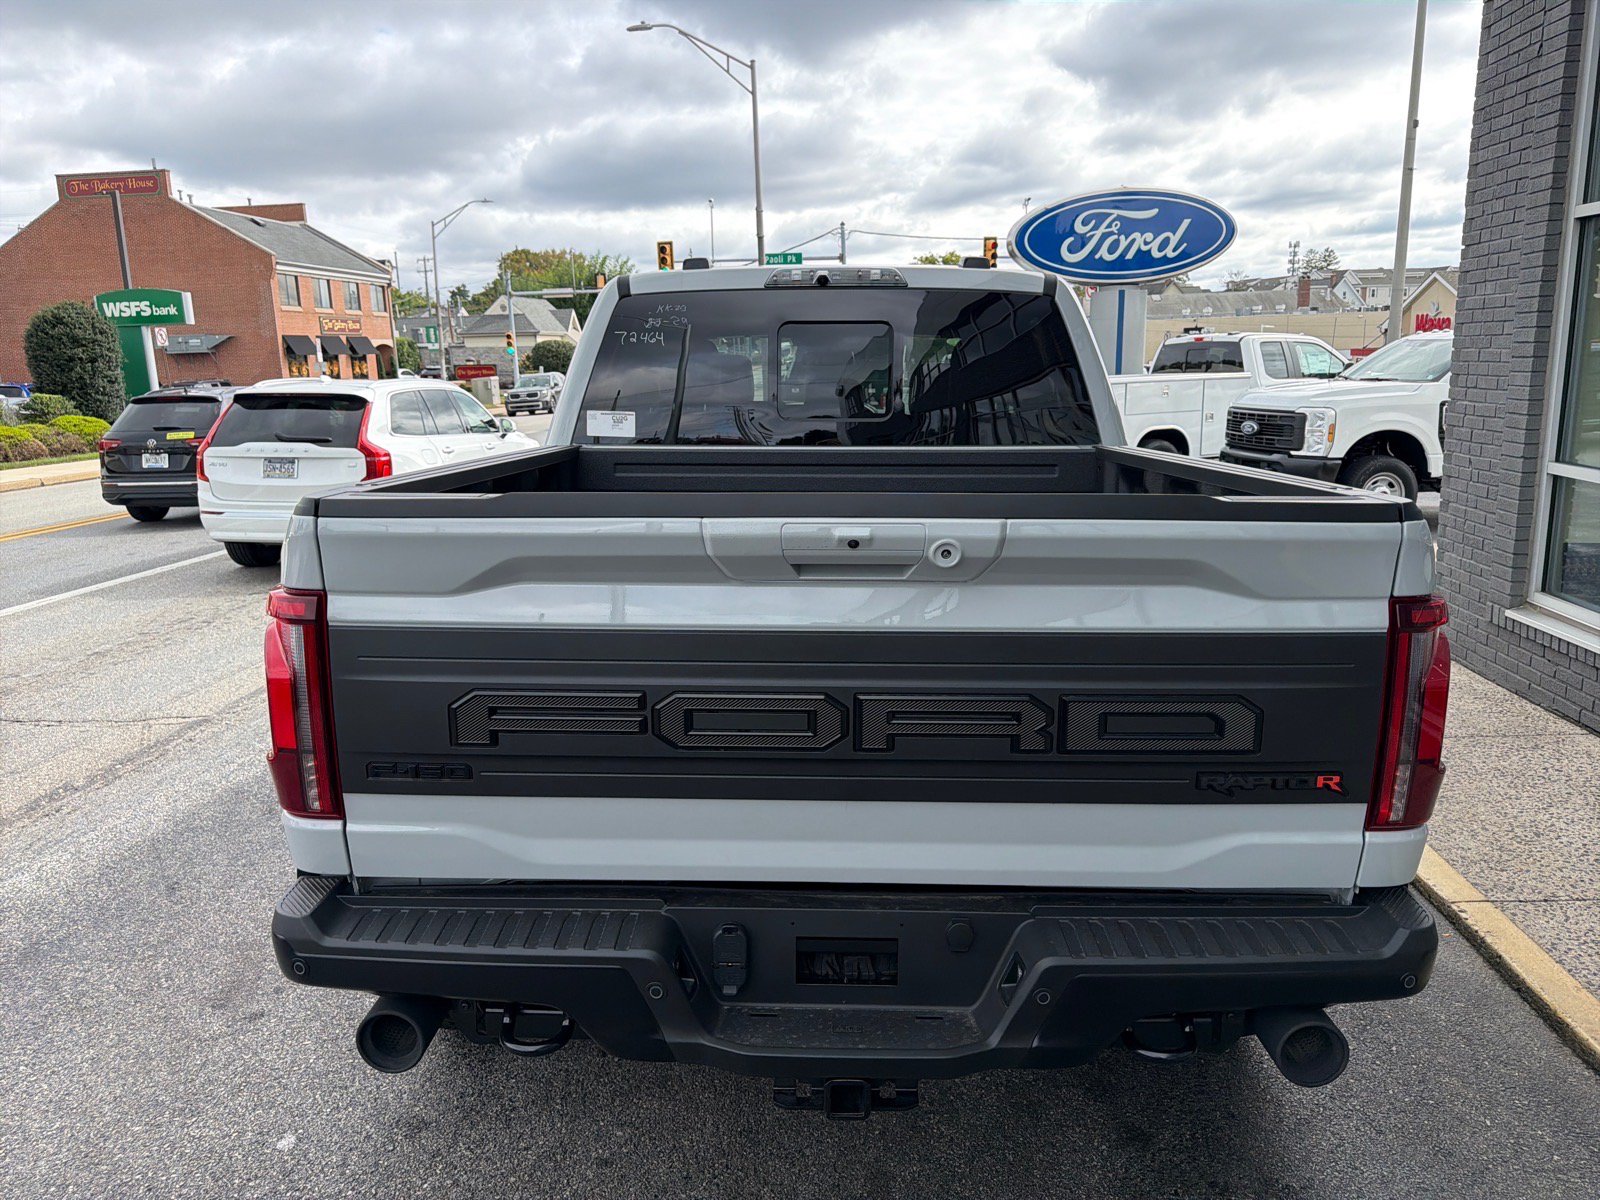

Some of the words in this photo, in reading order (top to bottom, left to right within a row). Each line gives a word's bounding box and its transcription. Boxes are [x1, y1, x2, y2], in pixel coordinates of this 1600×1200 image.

[69, 180, 89, 194] The
[91, 178, 125, 193] Bakery
[126, 177, 155, 190] House
[1060, 207, 1192, 263] Ford
[764, 254, 784, 264] Paoli
[787, 254, 797, 263] Pk
[102, 300, 152, 318] WSFS
[152, 303, 179, 316] bank
[614, 331, 665, 346] 72464
[449, 688, 1264, 756] FORD
[1196, 772, 1344, 798] RAPTOR
